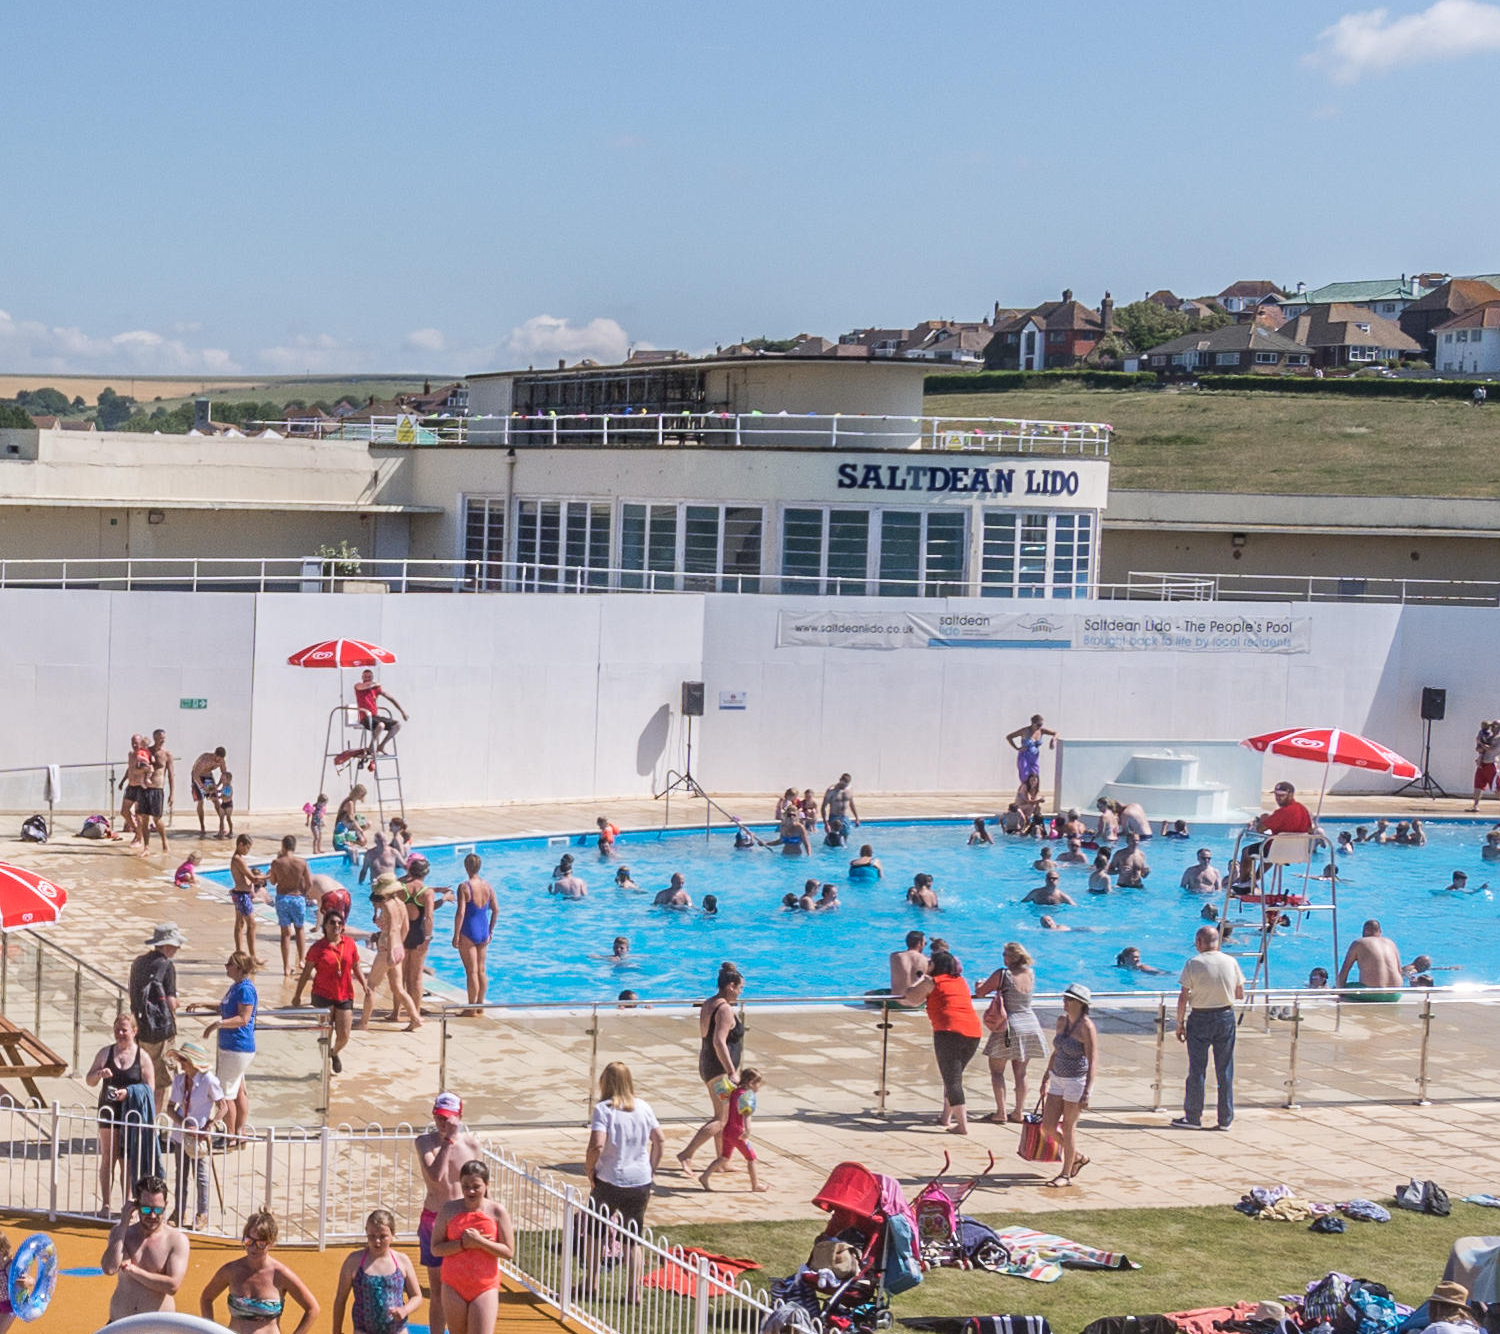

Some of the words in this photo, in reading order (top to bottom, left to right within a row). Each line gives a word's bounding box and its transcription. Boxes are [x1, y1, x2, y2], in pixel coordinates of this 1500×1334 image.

[838, 463, 1015, 493] SALTDEAN
[1025, 469, 1079, 495] LIDO
[939, 614, 990, 626] saltdean
[1084, 618, 1141, 632] Saltdean
[1145, 619, 1171, 632] Lido
[1185, 620, 1206, 633] The
[1210, 620, 1262, 635] People's
[1266, 621, 1293, 633] Pool
[795, 622, 914, 634] www.saltdeanlido.co.uk
[938, 625, 960, 636] lido
[1083, 635, 1125, 648] Brought
[1129, 635, 1158, 647] back
[1161, 636, 1173, 647] to
[1175, 636, 1192, 647] life
[1195, 636, 1209, 649] by
[1212, 636, 1240, 648] local
[1244, 636, 1291, 648] residents
